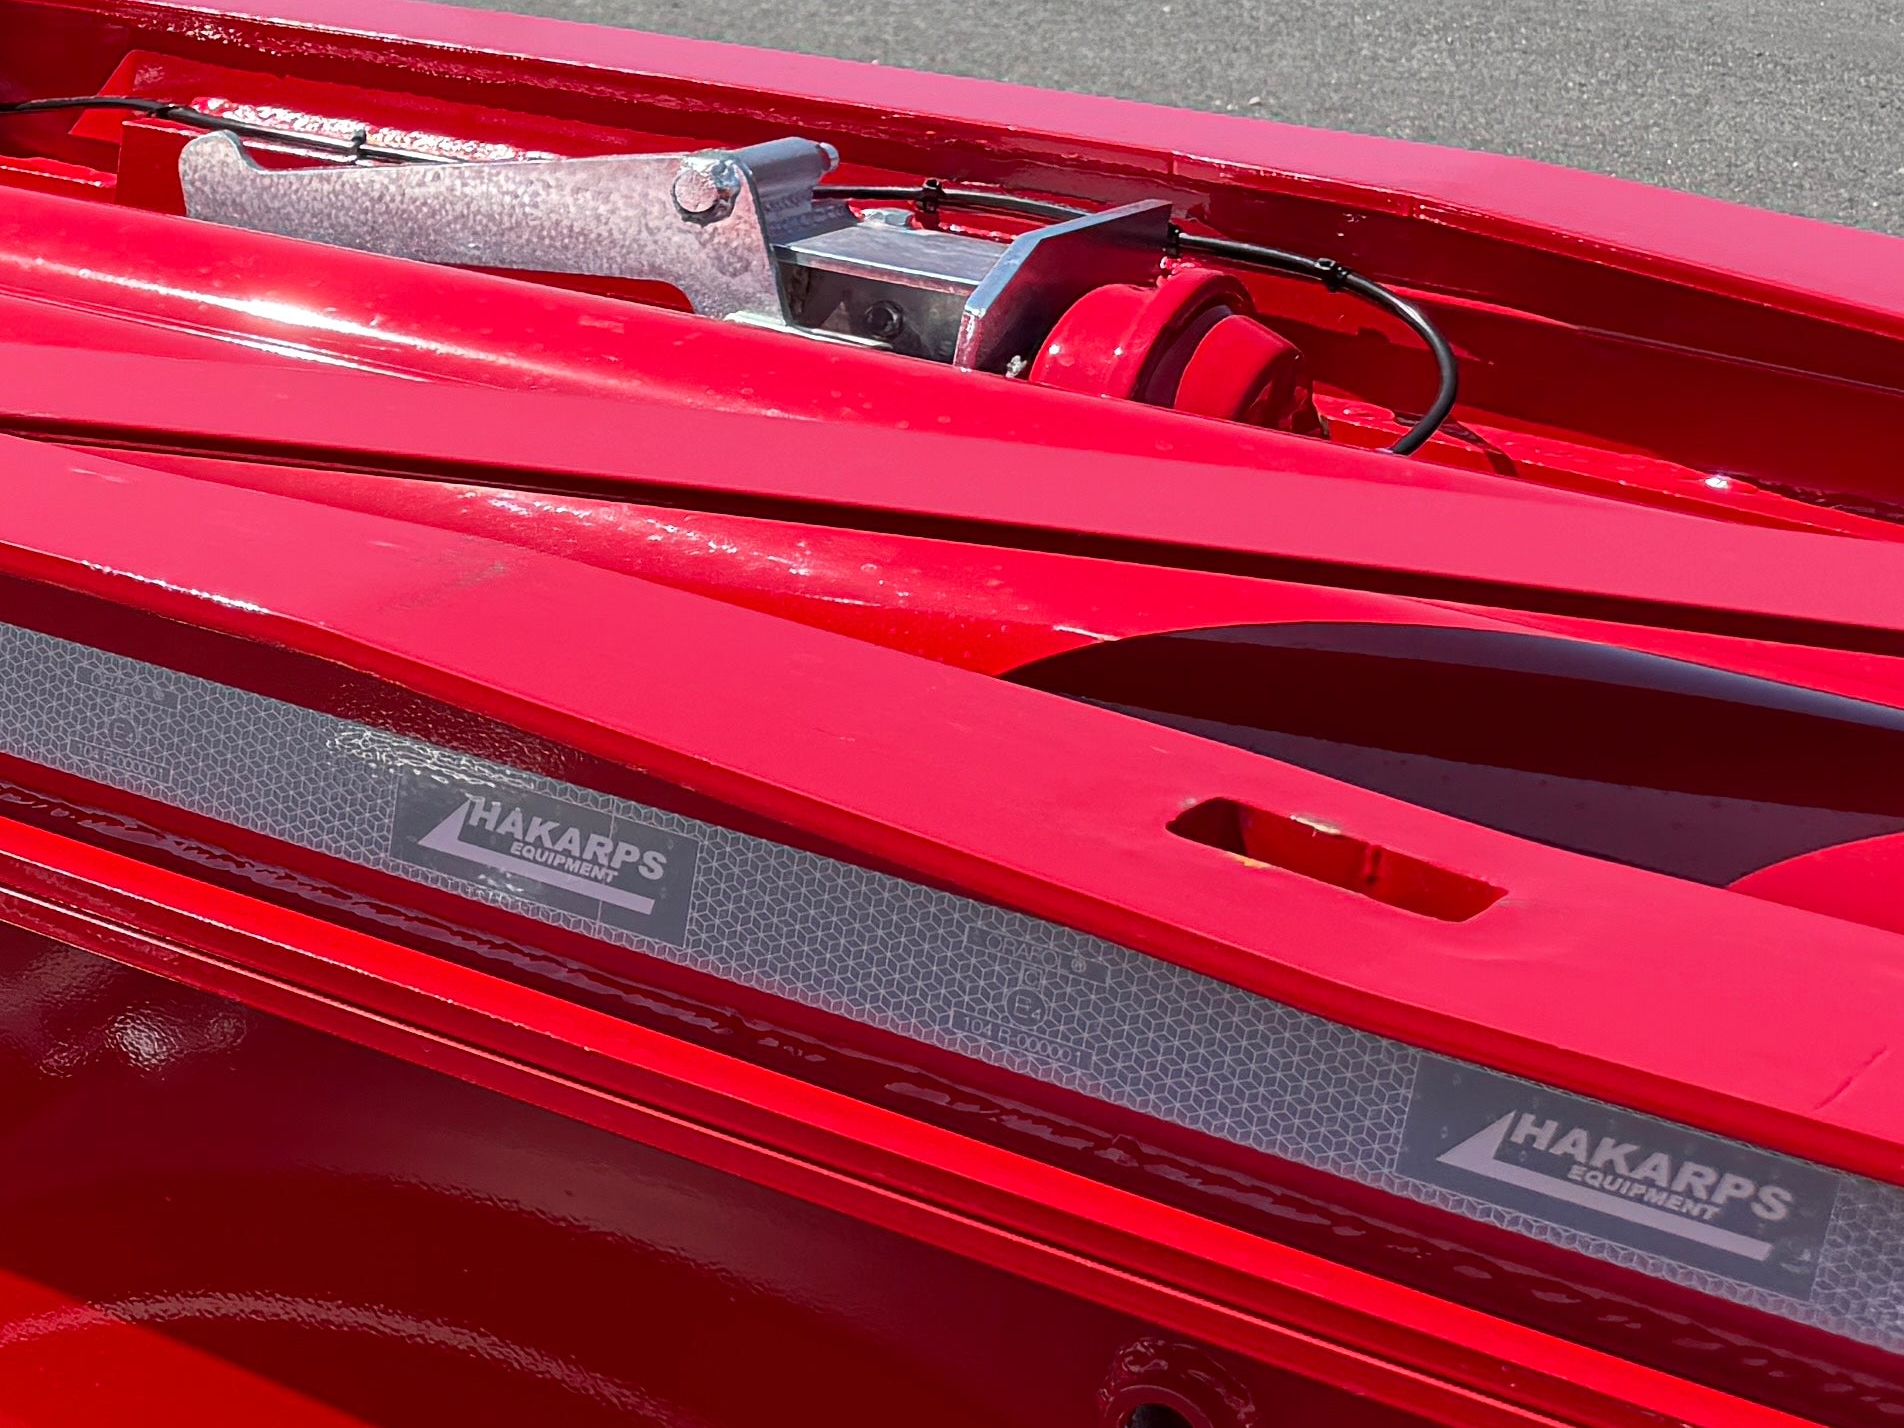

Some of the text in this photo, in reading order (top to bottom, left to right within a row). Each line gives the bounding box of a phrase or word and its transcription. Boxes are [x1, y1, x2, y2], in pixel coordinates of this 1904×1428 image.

[469, 794, 667, 880] HAKARPS
[510, 842, 618, 883] EQUIPMENT
[1510, 1113, 1793, 1222] HAKARPS
[1567, 1164, 1721, 1221] EQUIPMENT
